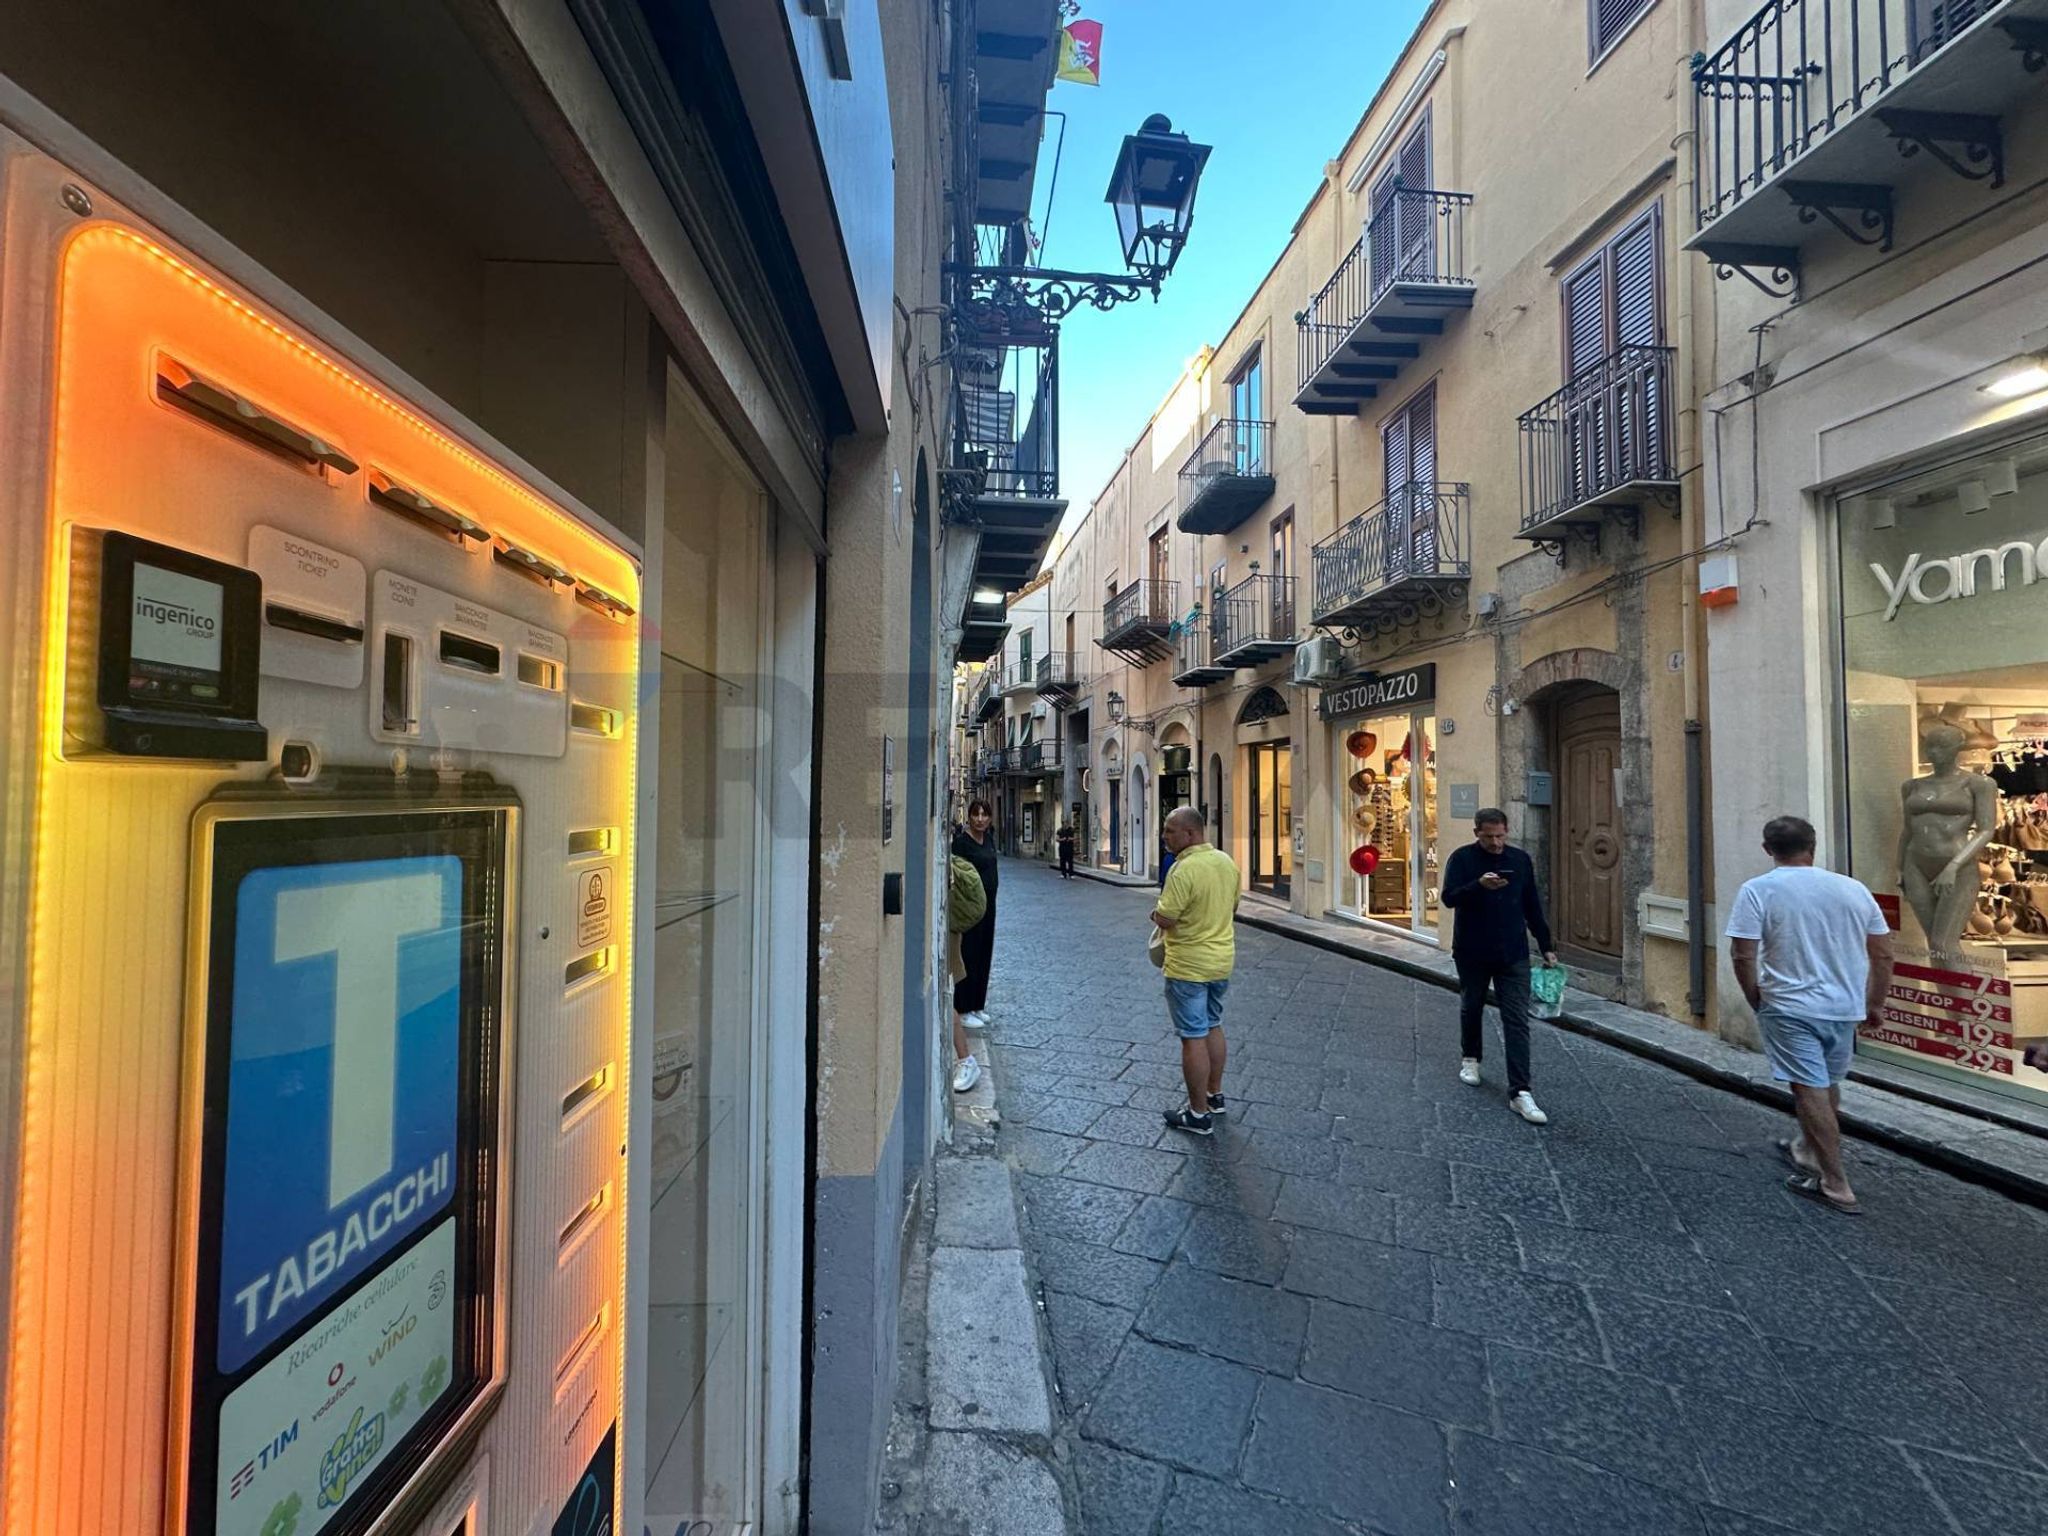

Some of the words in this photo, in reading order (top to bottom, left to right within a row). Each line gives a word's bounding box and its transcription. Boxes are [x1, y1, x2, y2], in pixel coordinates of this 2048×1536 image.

[284, 541, 340, 569] SCONTRINO
[1869, 535, 2048, 622] yam
[136, 596, 215, 631] ingenico
[1326, 672, 1419, 714] VESTOPAZZO
[1887, 987, 1953, 1008] LIE/TOP
[1972, 996, 1993, 1022] 9
[1972, 970, 1993, 998] 7
[1882, 1008, 1939, 1031] GGISENI
[1958, 1019, 1994, 1048] 19
[1955, 1044, 1995, 1073] 29
[235, 1151, 449, 1337] TABACCHI
[368, 1315, 417, 1367] WIND
[312, 1376, 358, 1422] vodafone
[258, 1418, 299, 1470] TIM
